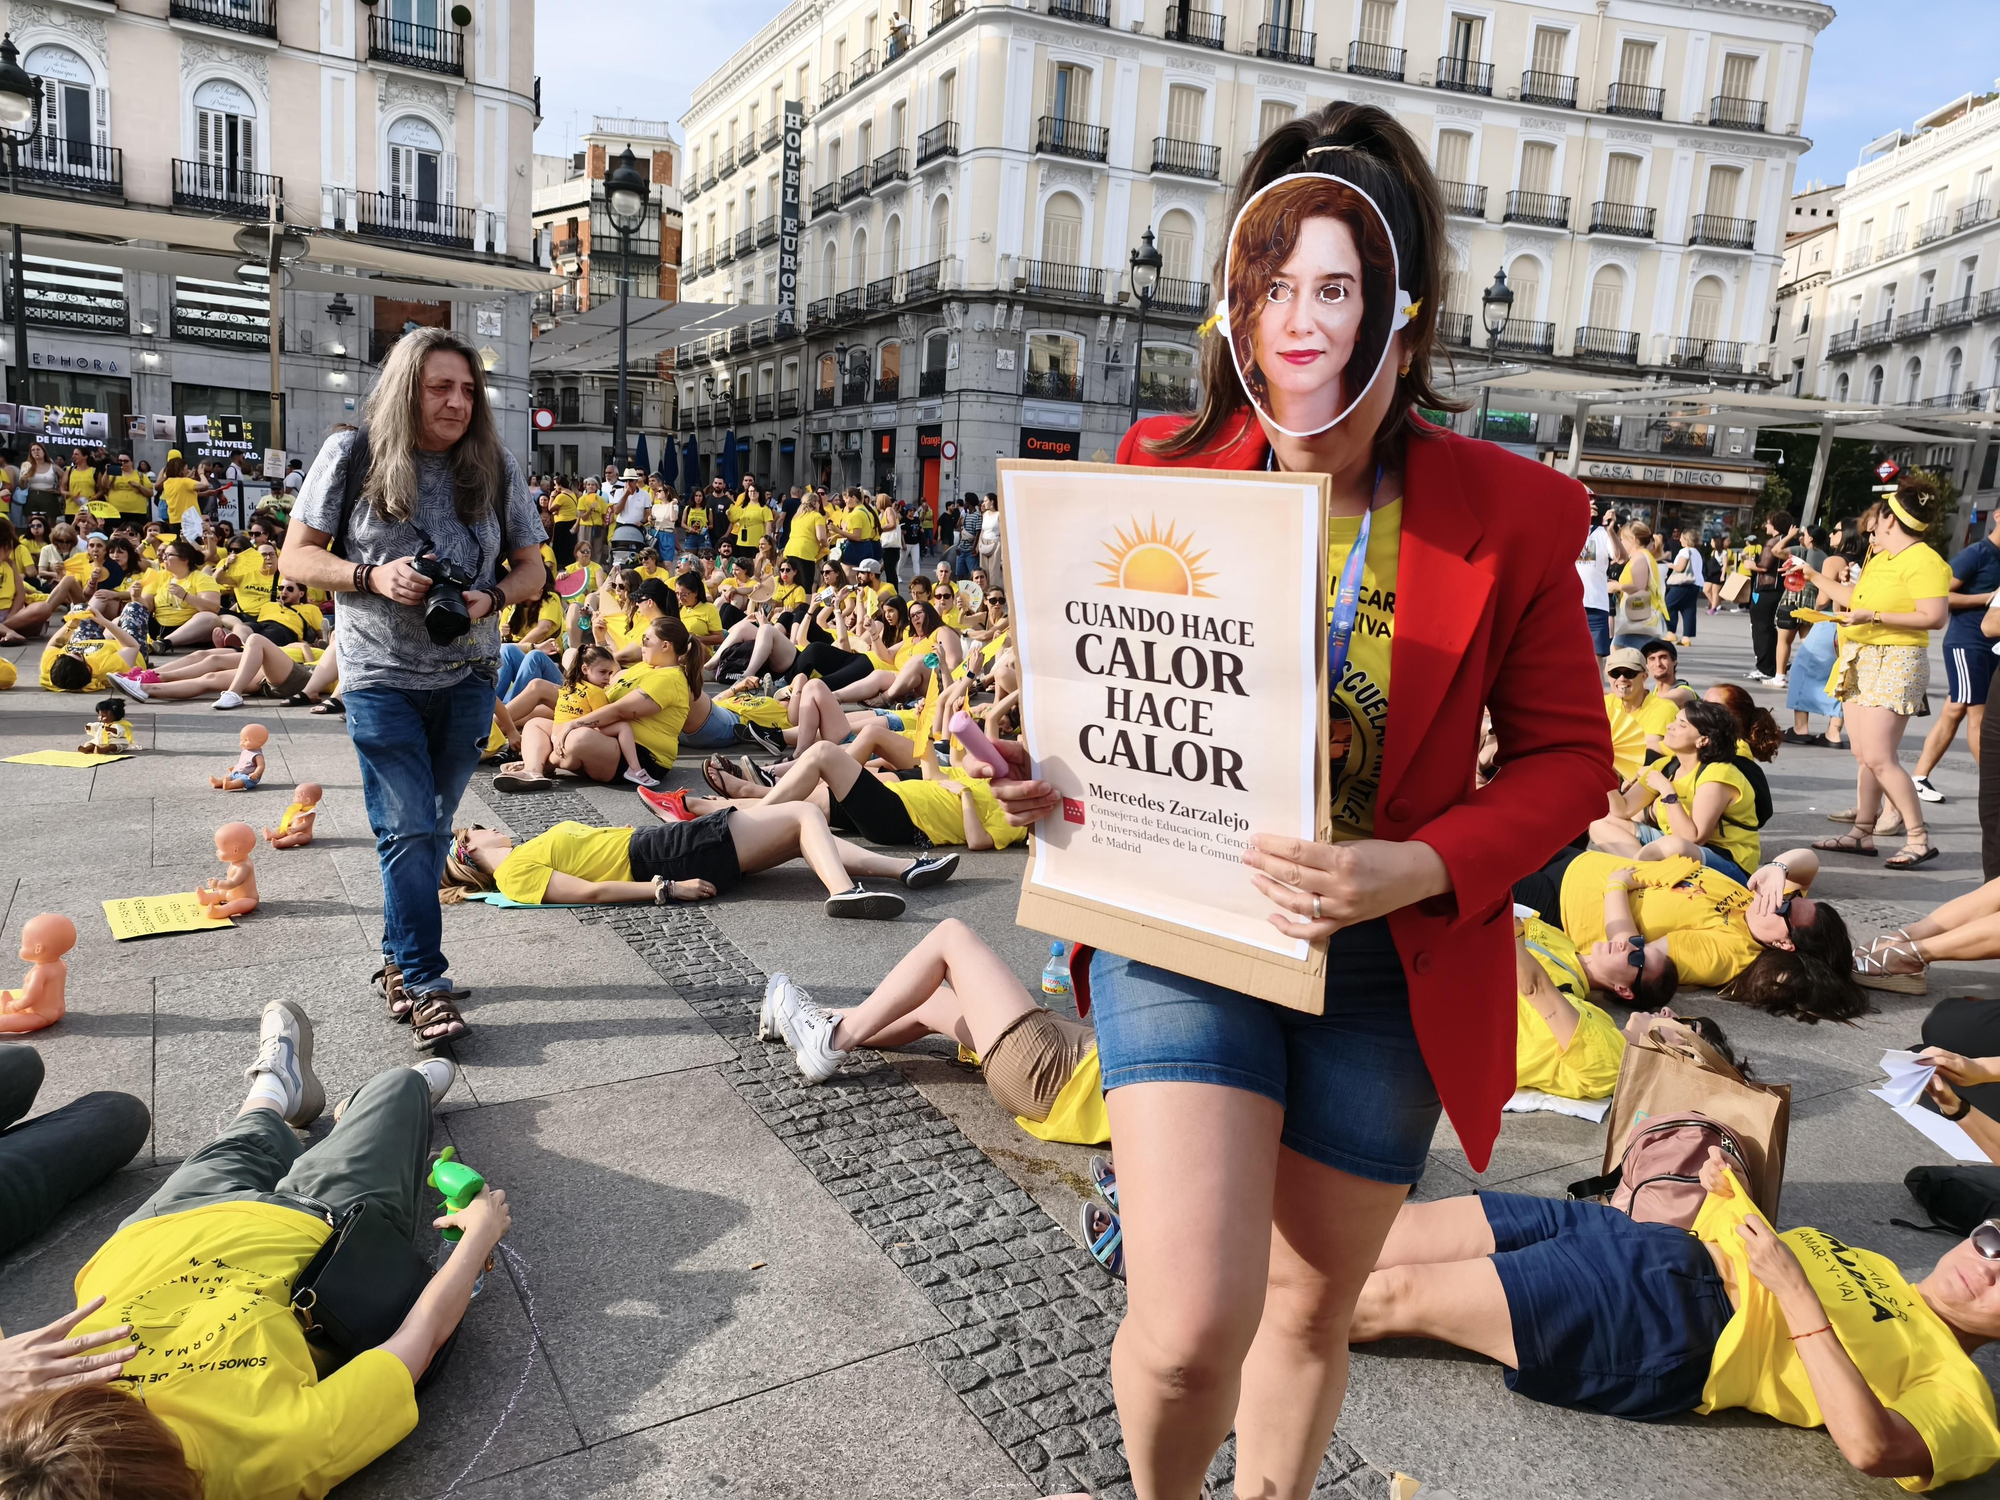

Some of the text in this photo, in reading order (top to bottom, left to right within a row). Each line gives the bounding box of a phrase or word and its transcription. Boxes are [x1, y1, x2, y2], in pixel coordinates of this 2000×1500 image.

[779, 111, 803, 325] HOTEL EUROPA
[420, 298, 440, 307] VIBES
[32, 352, 118, 372] EPHORA
[44, 405, 51, 413] 3
[45, 425, 52, 434] 3
[35, 435, 107, 448] DE FELICIDAD.
[214, 440, 253, 449] NIVELES
[920, 434, 942, 447] Orange
[1027, 437, 1071, 454] Orange
[197, 448, 262, 460] DE FELIAD.
[1588, 463, 1724, 486] CASA DE DIEGO
[1065, 600, 1255, 648] CUANDO HACE
[1075, 633, 1250, 698] CALOR
[1104, 685, 1214, 737] HACE
[1078, 723, 1249, 792] CALOR
[1088, 782, 1250, 833] Mercedes Zarzalejo
[1090, 804, 1139, 825] Consejera
[1141, 816, 1154, 828] de
[1156, 819, 1213, 843] Educacion,
[1091, 820, 1098, 831] y
[1099, 821, 1170, 847] Universidades
[1173, 840, 1186, 850] de
[1188, 842, 1198, 853] la
[1091, 833, 1142, 855] de Madrid
[217, 1356, 268, 1371] SOMOS
